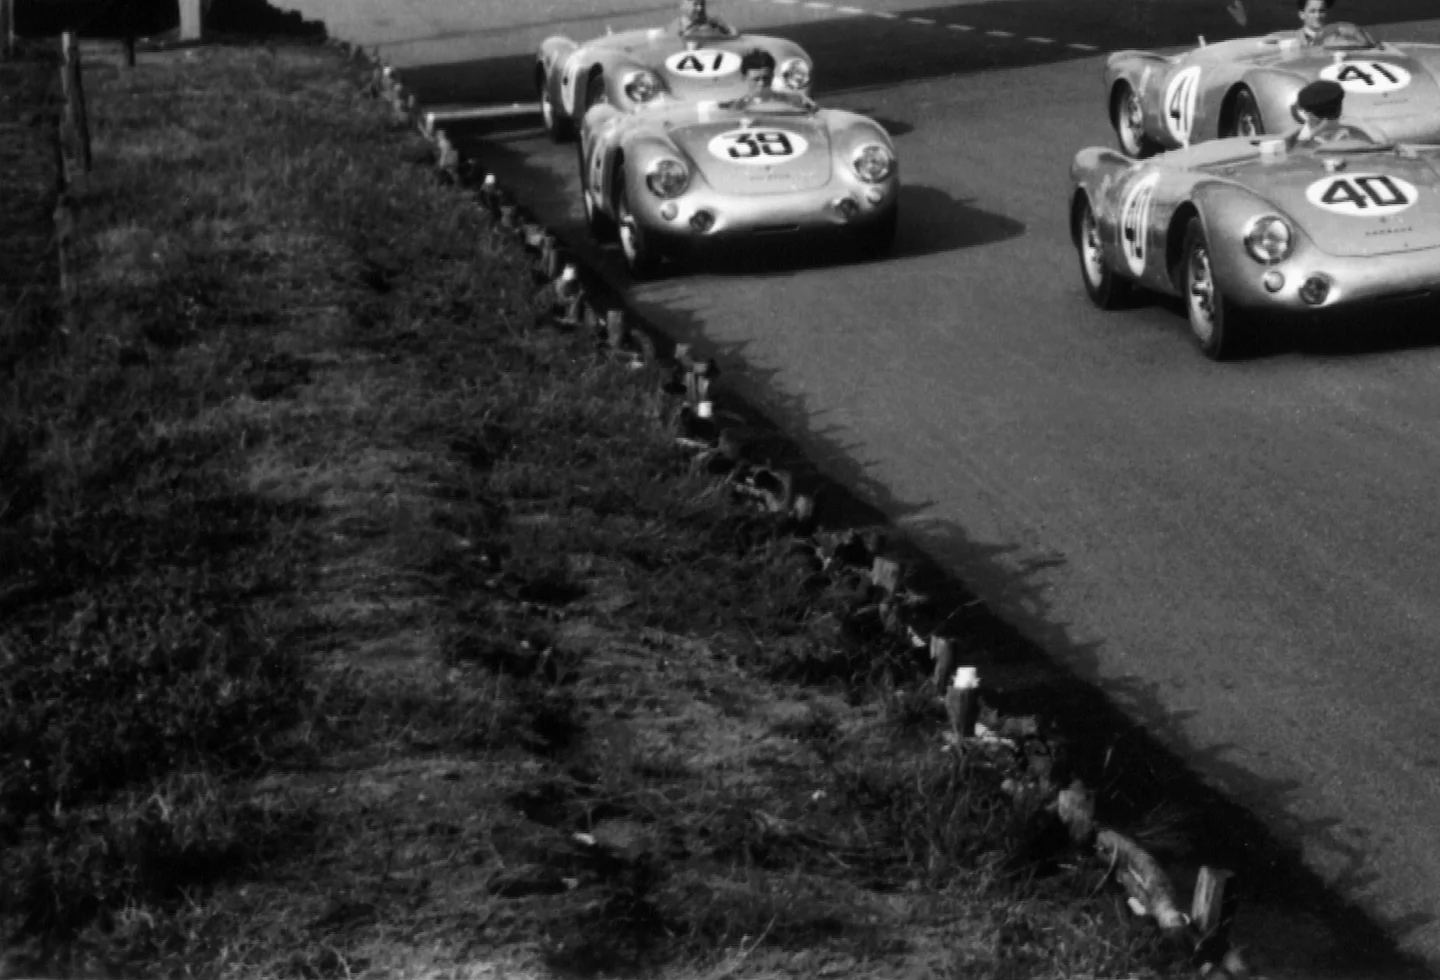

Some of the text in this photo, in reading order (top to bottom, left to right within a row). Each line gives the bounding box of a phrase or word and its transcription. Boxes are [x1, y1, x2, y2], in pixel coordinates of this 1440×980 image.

[1337, 64, 1400, 86] 41
[720, 132, 794, 158] 39
[1321, 175, 1409, 209] 40
